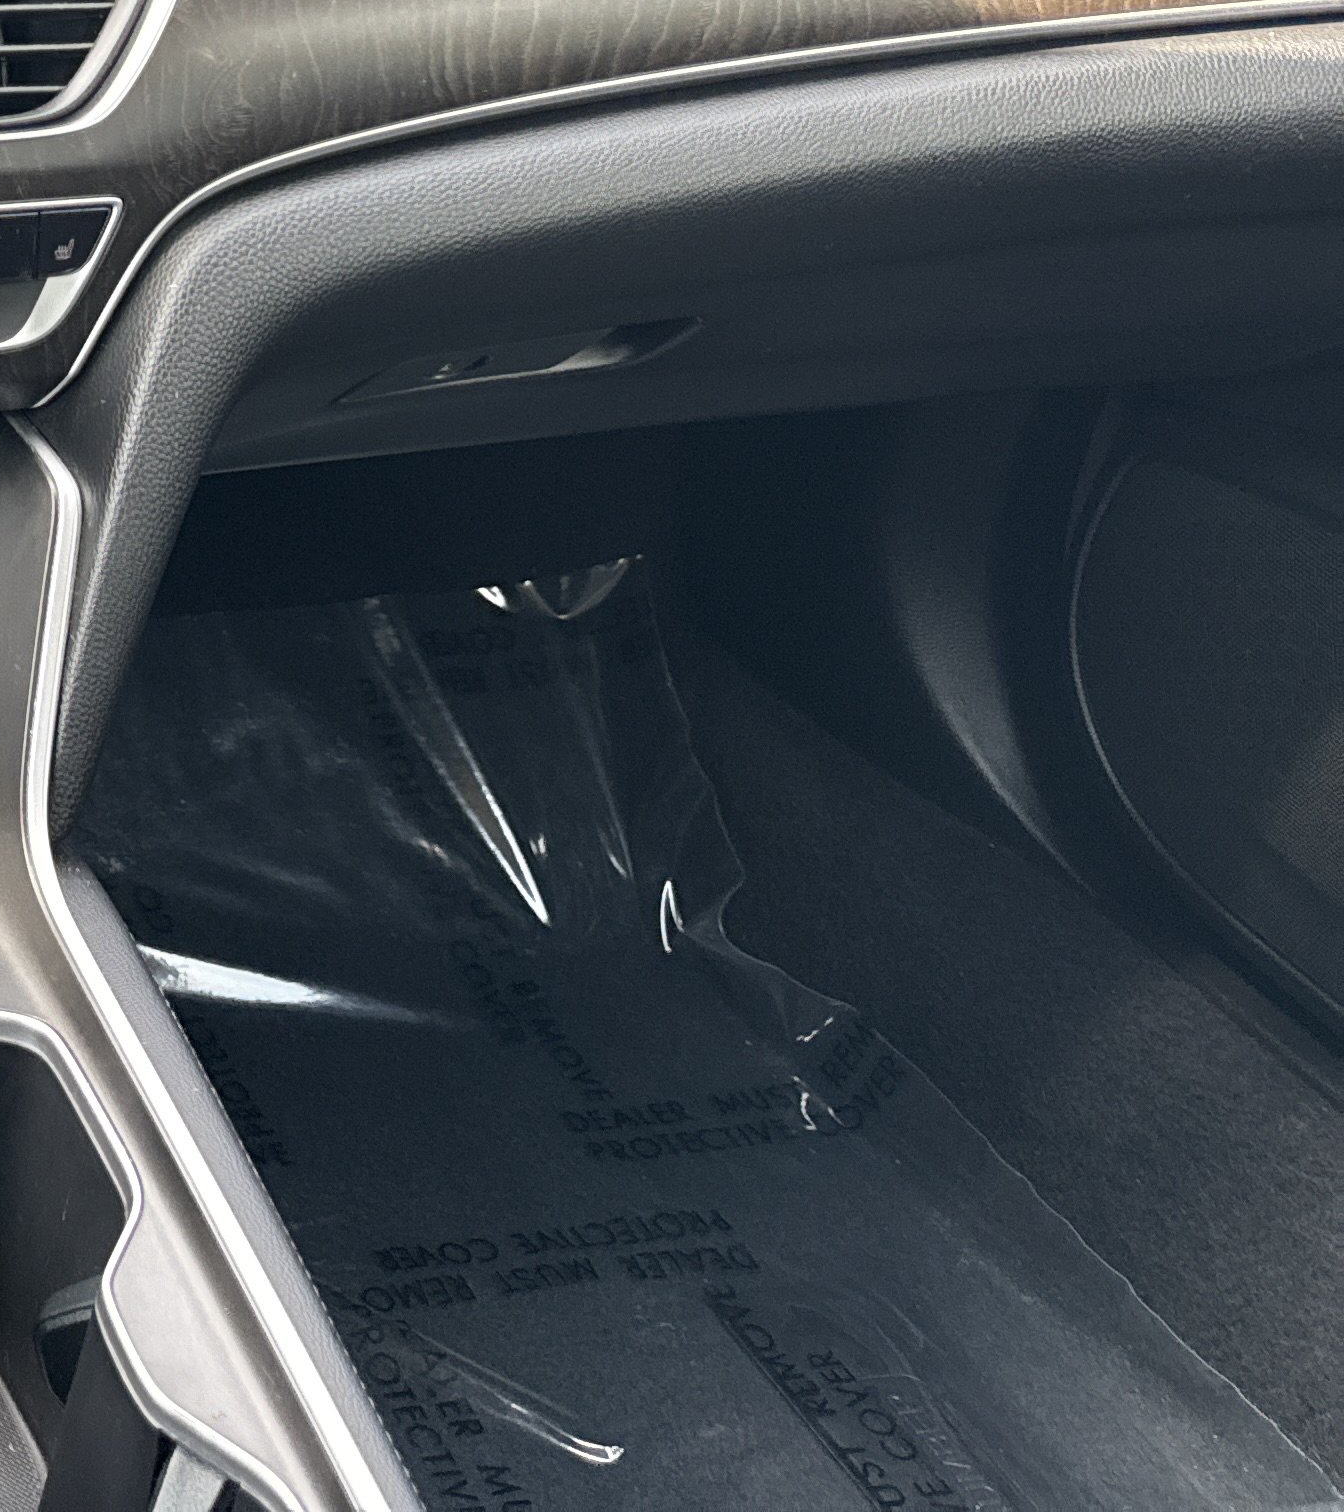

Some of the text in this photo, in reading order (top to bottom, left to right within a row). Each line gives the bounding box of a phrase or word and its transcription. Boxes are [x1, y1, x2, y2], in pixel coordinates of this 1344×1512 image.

[561, 1098, 694, 1134] DEALER
[370, 1208, 734, 1274] PROTECTIVE COVER
[497, 1256, 601, 1294] MUST
[617, 1241, 760, 1281] DEALER
